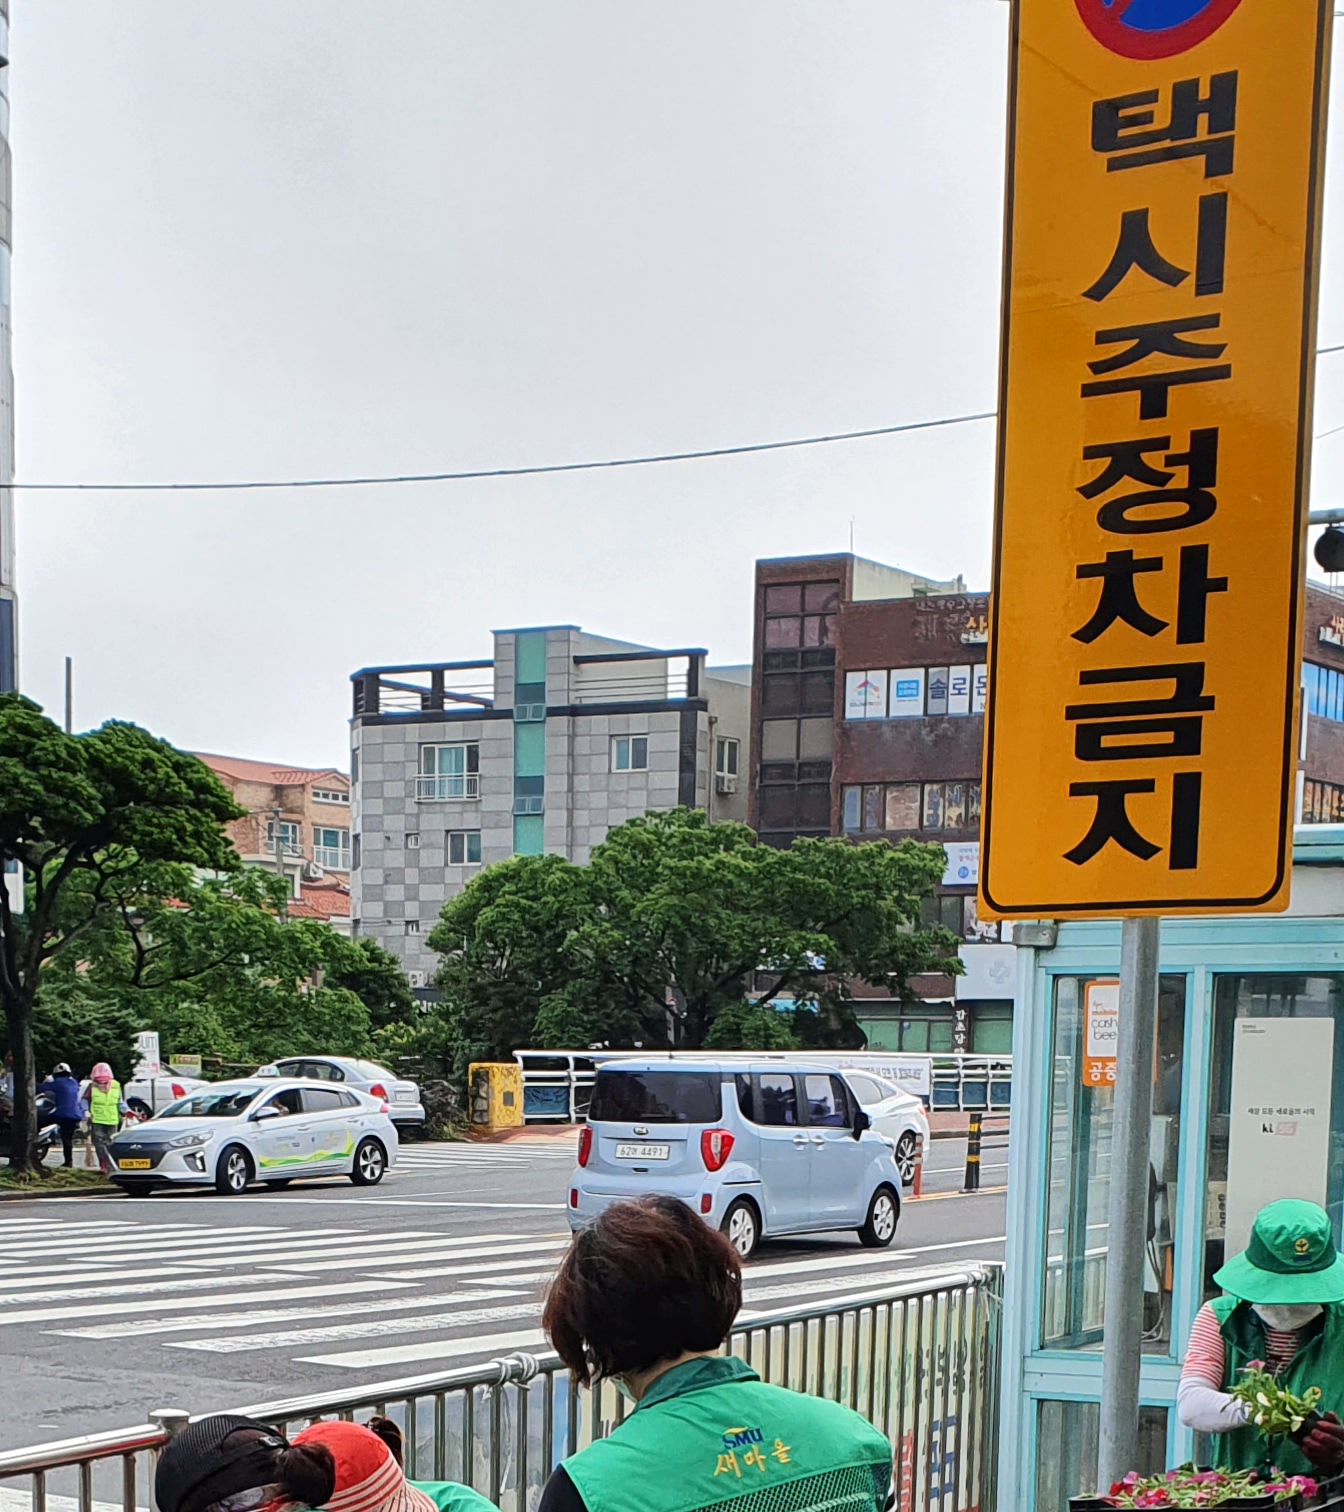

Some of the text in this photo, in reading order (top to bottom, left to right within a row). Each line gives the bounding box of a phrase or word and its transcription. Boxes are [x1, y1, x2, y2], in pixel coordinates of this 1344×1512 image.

[1061, 68, 1239, 871] 택시주정차금지
[1093, 1027, 1118, 1041] bee
[721, 1428, 764, 1450] SMU
[713, 1438, 792, 1478] 새마을
